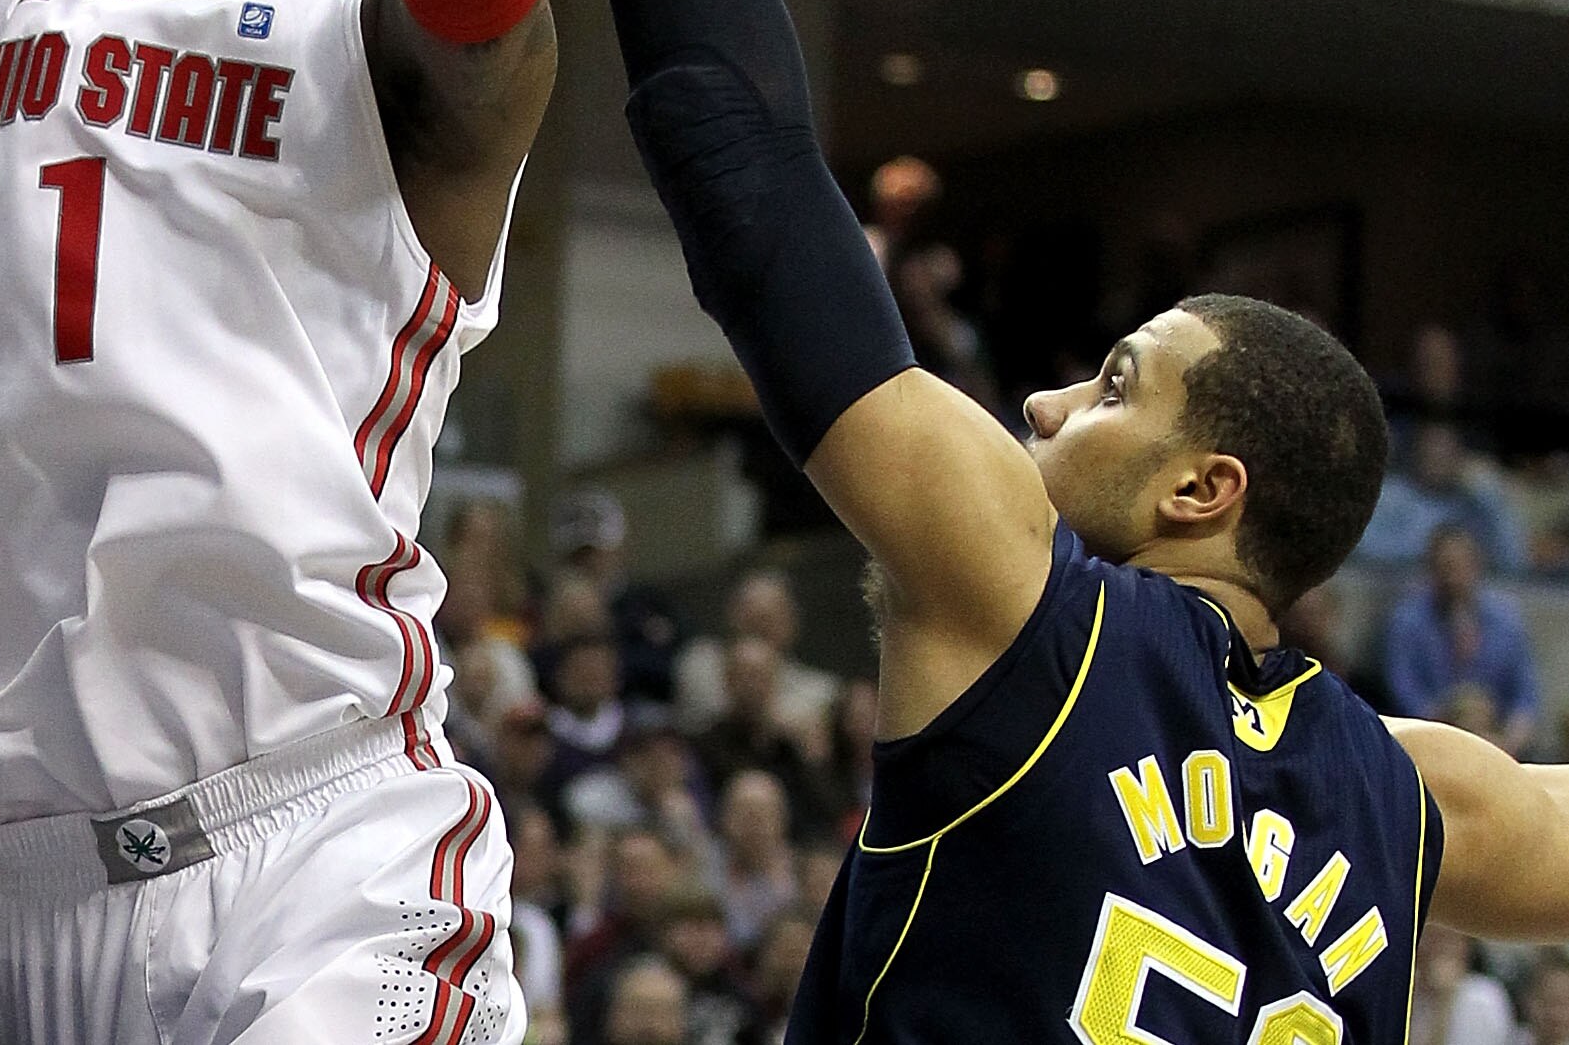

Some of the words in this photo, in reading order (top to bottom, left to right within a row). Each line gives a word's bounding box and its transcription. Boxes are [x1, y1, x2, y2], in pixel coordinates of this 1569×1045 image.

[75, 34, 296, 162] STATE
[38, 156, 108, 366] 1
[1108, 749, 1389, 997] MOGAN
[1066, 891, 1344, 1045] 5
